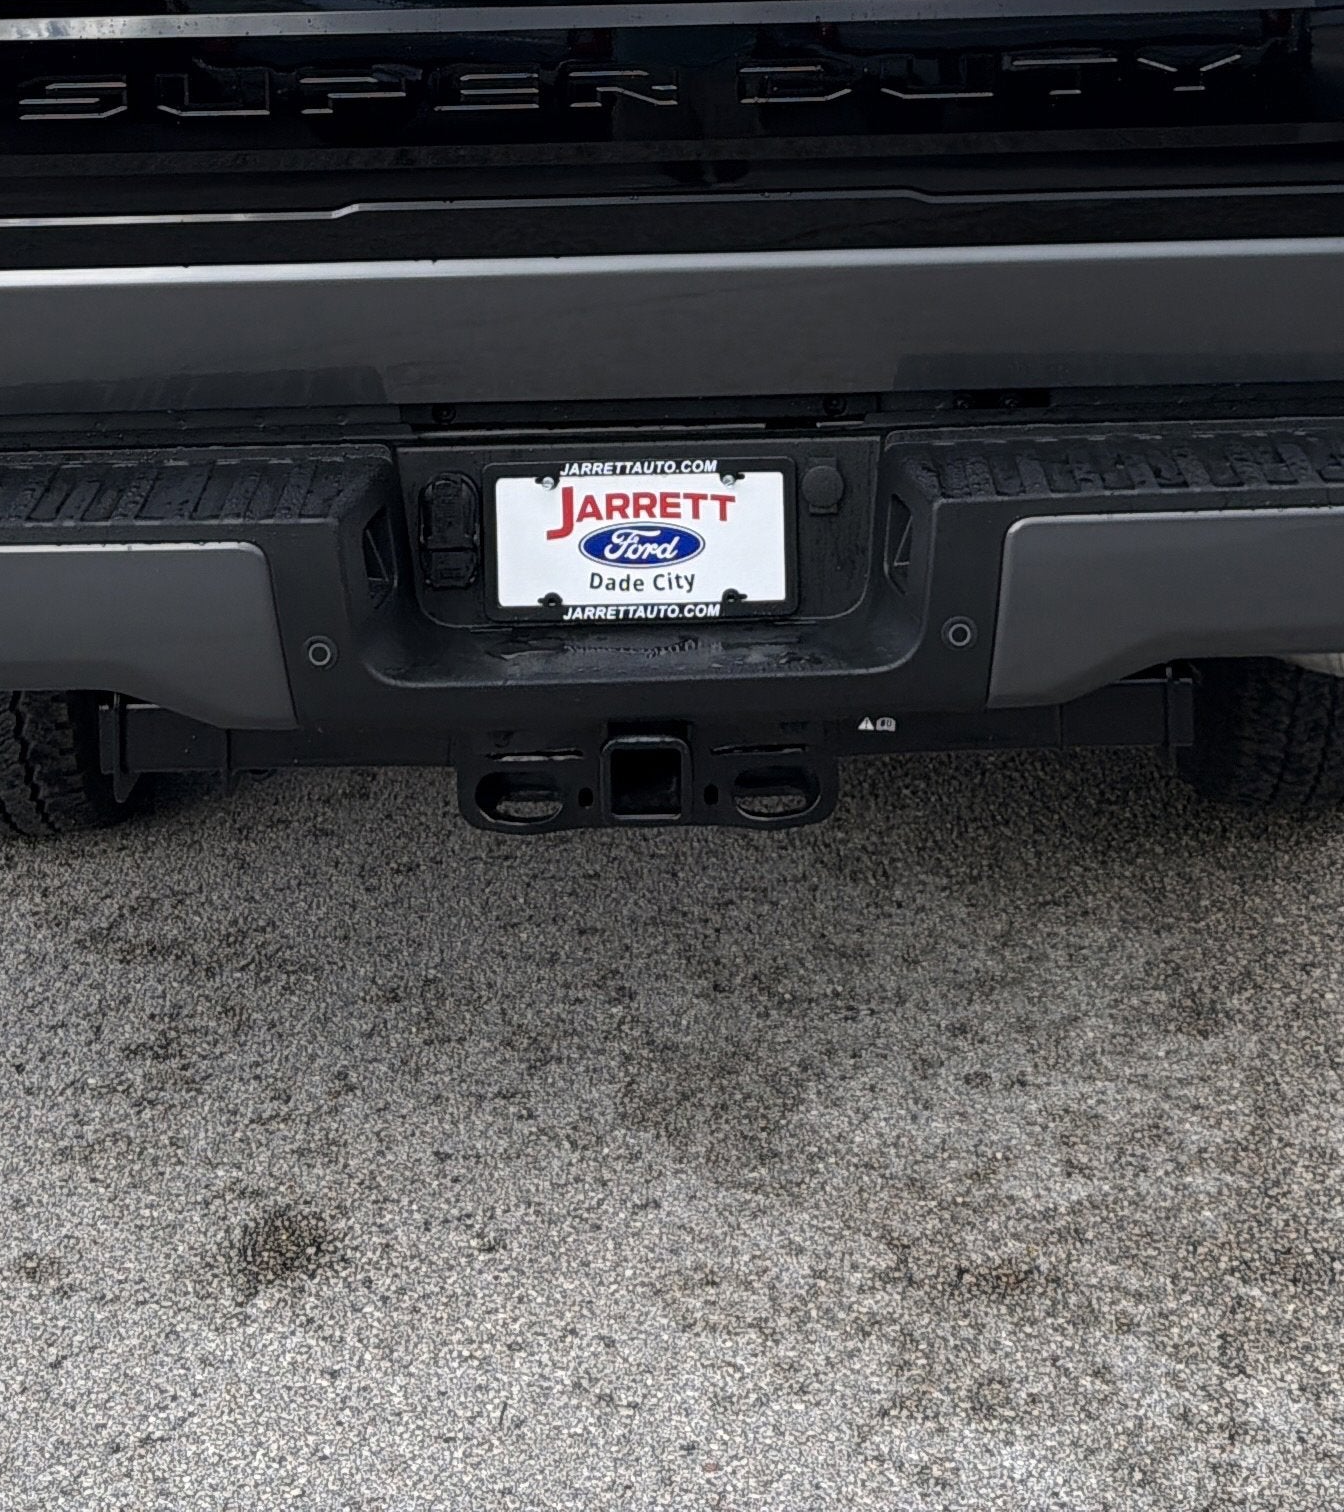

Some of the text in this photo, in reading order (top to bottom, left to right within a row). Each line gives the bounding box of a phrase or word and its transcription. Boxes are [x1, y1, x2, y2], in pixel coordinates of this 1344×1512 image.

[17, 49, 1243, 121] SUPER DUTY
[559, 459, 718, 477] JARRETTAUTO.COM
[546, 486, 737, 541] JARRETT
[603, 528, 681, 561] Ford
[589, 572, 696, 593] Dade City
[562, 603, 721, 622] JARRETTAUTO.COM
